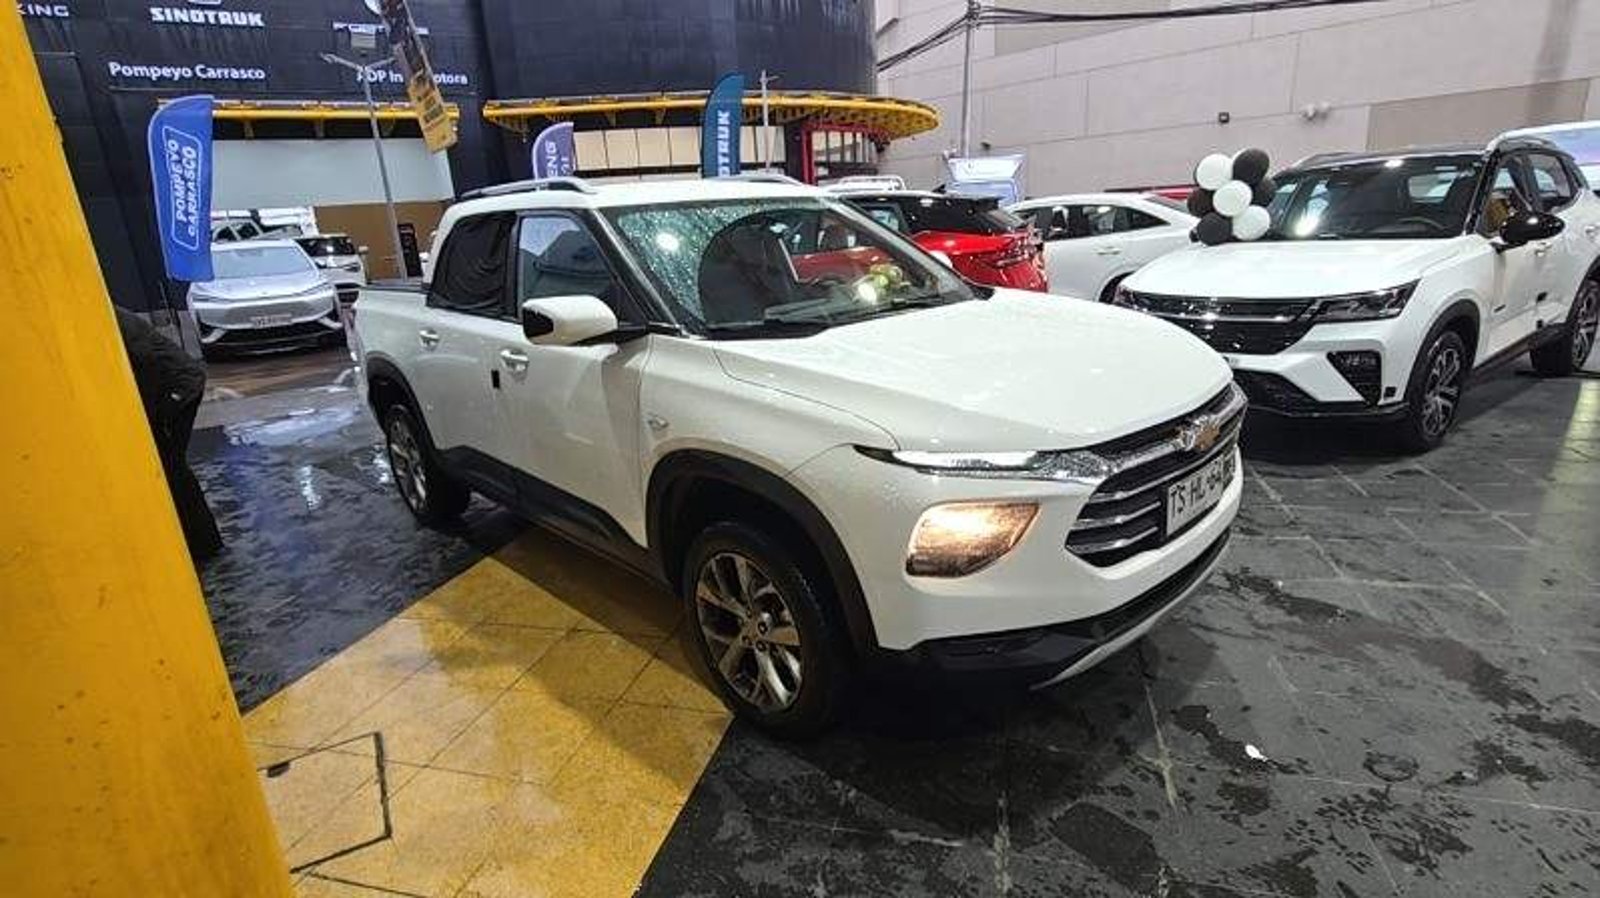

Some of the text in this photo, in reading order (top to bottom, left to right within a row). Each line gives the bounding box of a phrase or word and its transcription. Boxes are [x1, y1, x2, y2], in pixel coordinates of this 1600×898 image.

[150, 7, 265, 27] SINOTRUK
[108, 62, 266, 81] Pompeyo Carrasco
[167, 140, 187, 222] POMPEYO
[182, 146, 198, 237] CARRASCO
